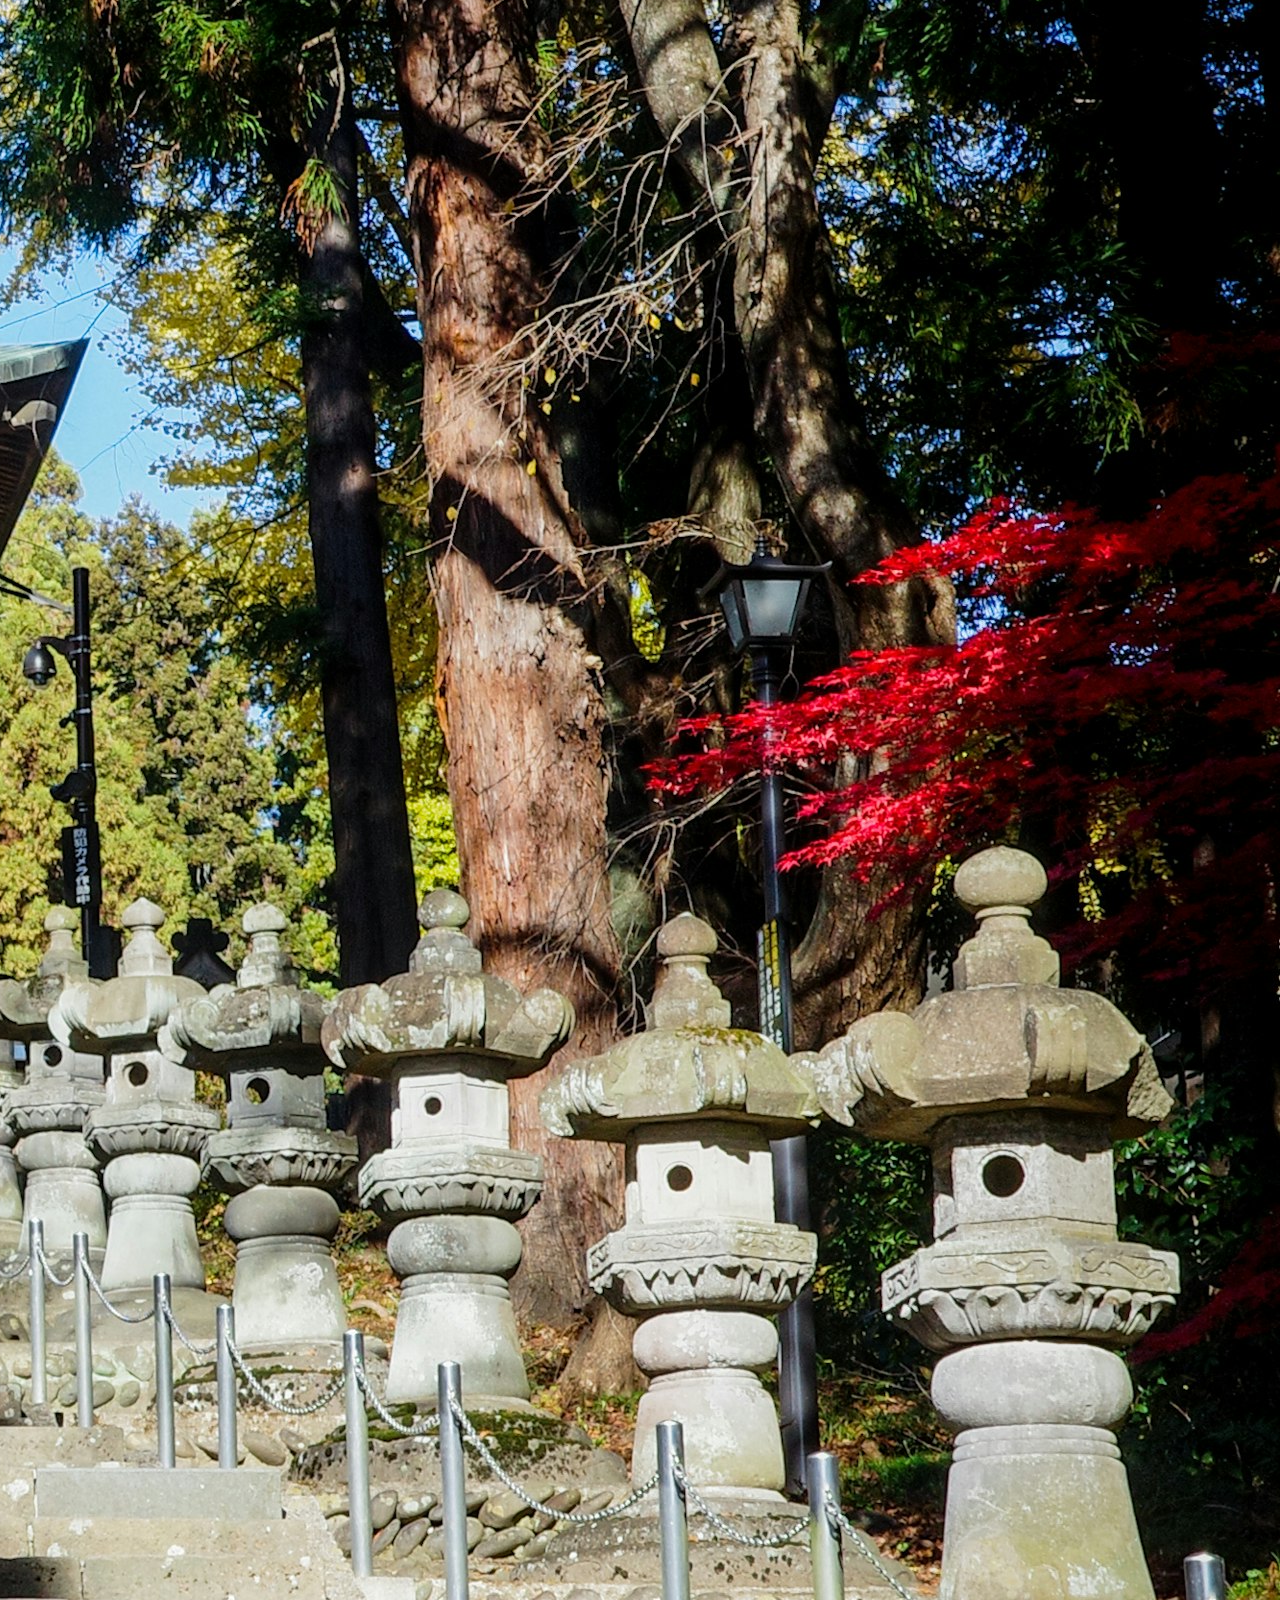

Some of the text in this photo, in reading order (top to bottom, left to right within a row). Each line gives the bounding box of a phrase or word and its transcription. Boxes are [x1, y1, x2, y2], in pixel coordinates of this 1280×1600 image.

[72, 827, 91, 905] 防犯カメラ作動中
